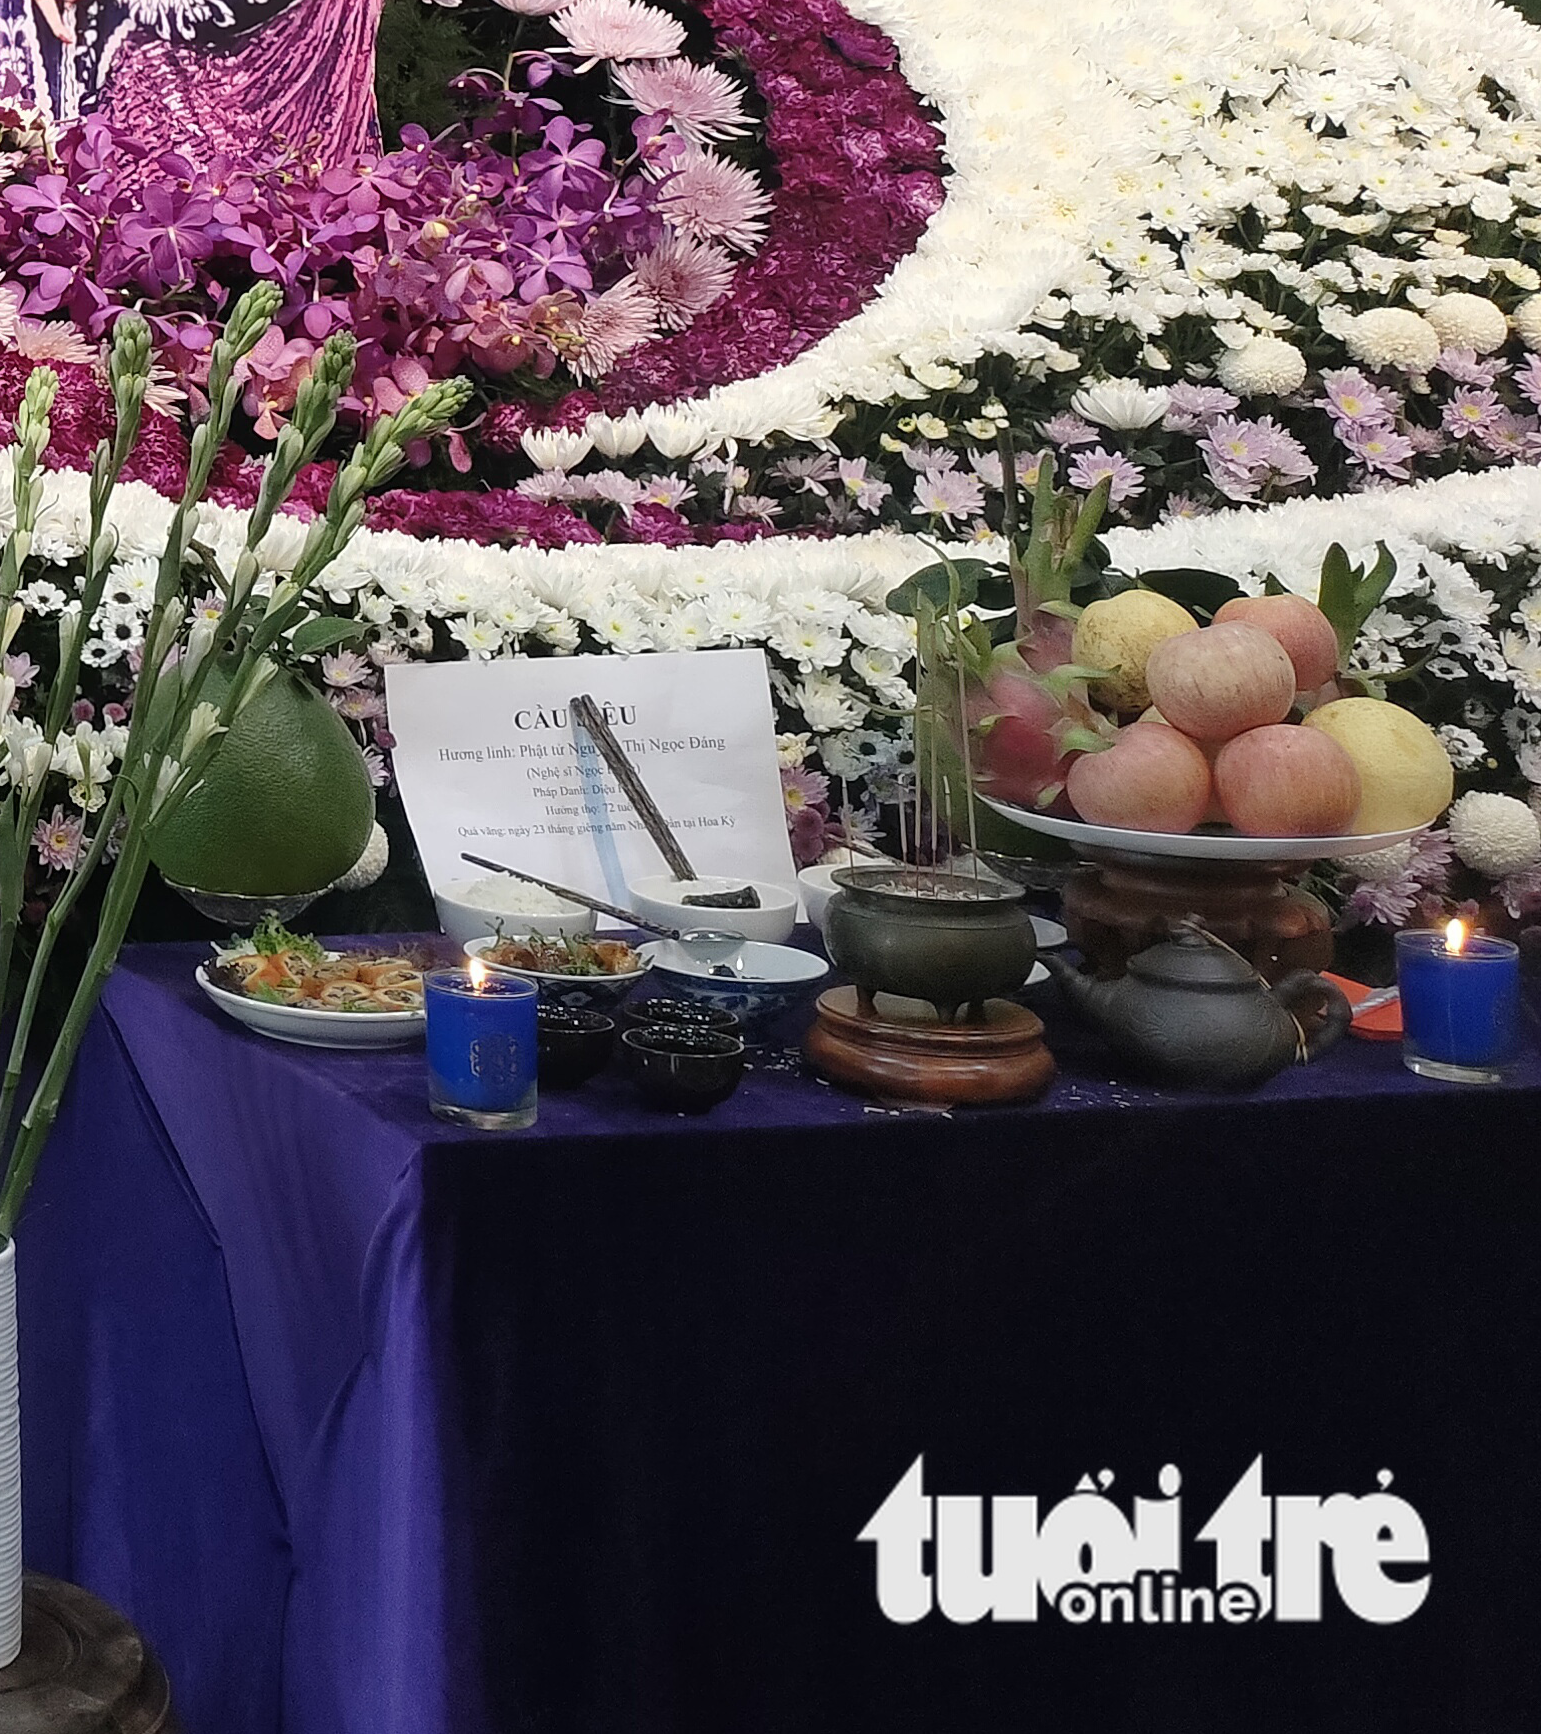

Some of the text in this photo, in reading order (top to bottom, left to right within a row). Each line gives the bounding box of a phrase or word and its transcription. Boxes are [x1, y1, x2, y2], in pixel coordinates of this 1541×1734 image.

[514, 701, 636, 730] CẦU ÊU
[438, 748, 484, 763] Hương
[486, 746, 516, 759] linh:
[519, 744, 548, 759] Phật
[623, 740, 645, 755] Thị
[648, 738, 684, 754] Ngọc
[527, 767, 560, 780] (Nghệ
[574, 763, 604, 778] Ngọc
[532, 787, 558, 799] Pháp
[592, 783, 615, 796] Diệu
[603, 802, 615, 813] 72
[533, 824, 545, 835] 23
[547, 823, 574, 836] tháng
[698, 816, 719, 827] Hoa
